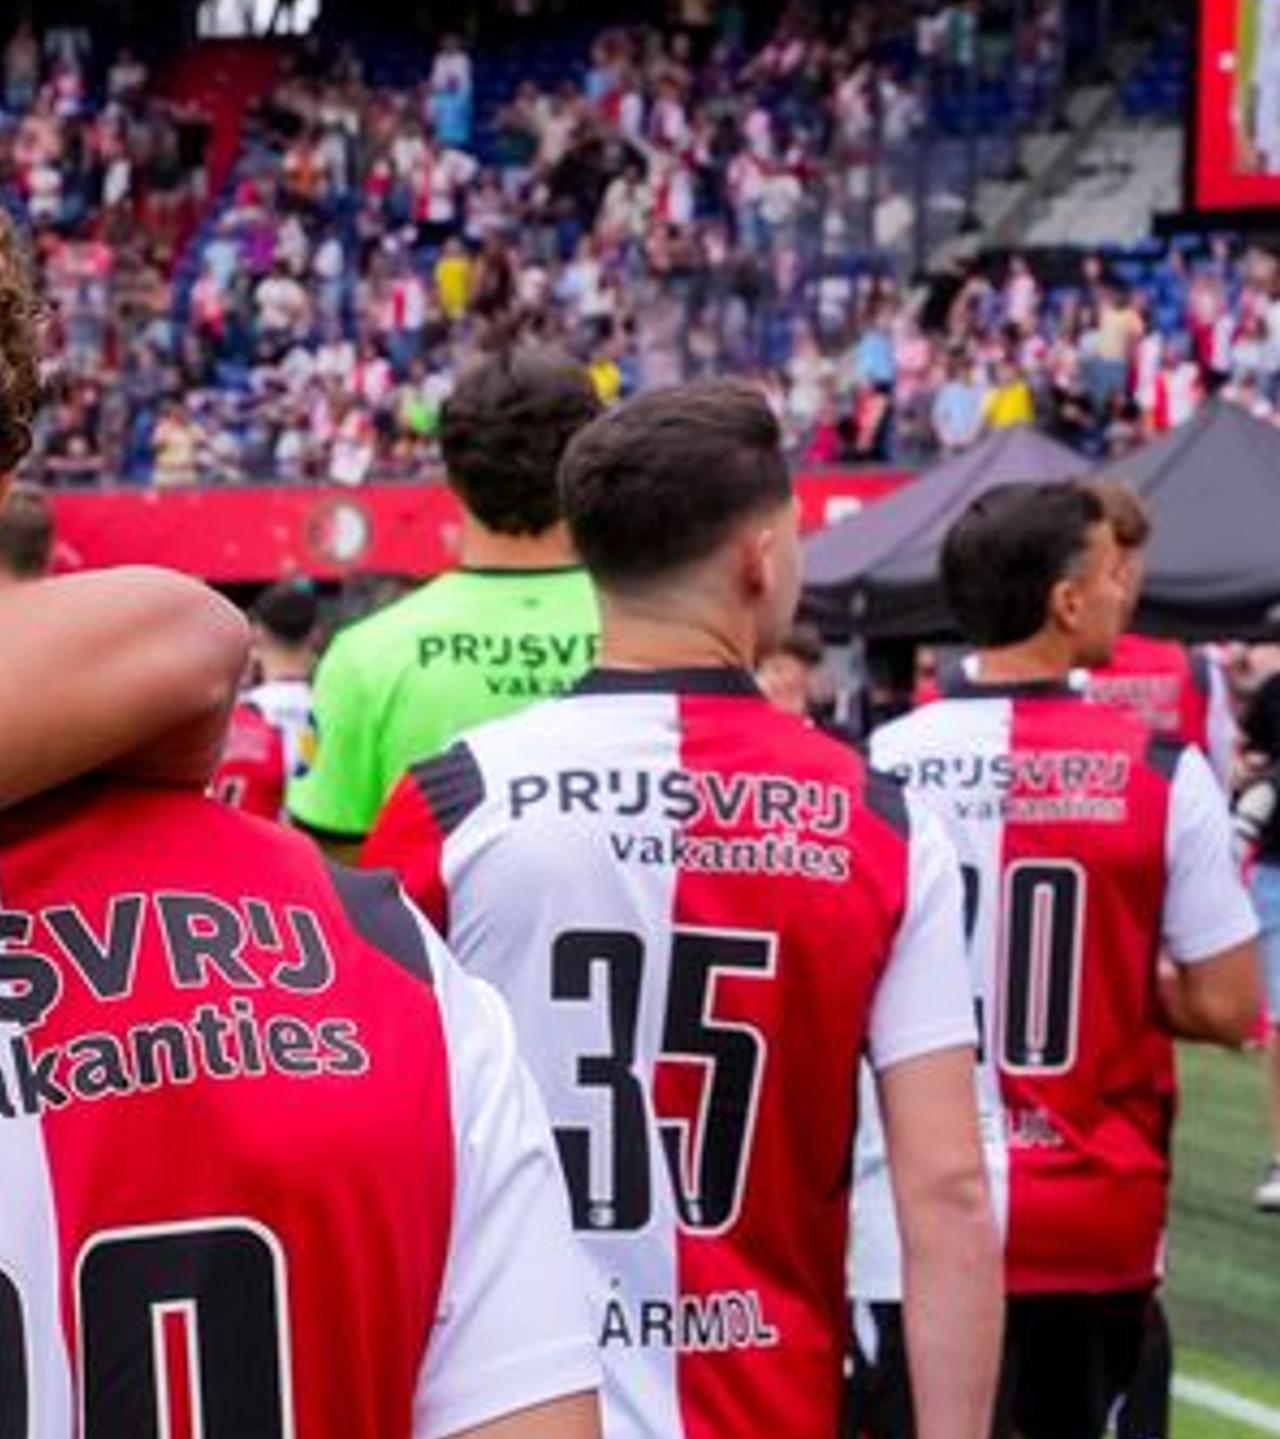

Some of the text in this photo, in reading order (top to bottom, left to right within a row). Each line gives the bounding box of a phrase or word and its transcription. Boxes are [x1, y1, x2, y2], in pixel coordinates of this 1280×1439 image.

[508, 768, 851, 836] PRIJSVRIJ
[609, 828, 851, 881] vakanties
[961, 858, 1086, 1076] 0
[549, 925, 780, 1236] 35
